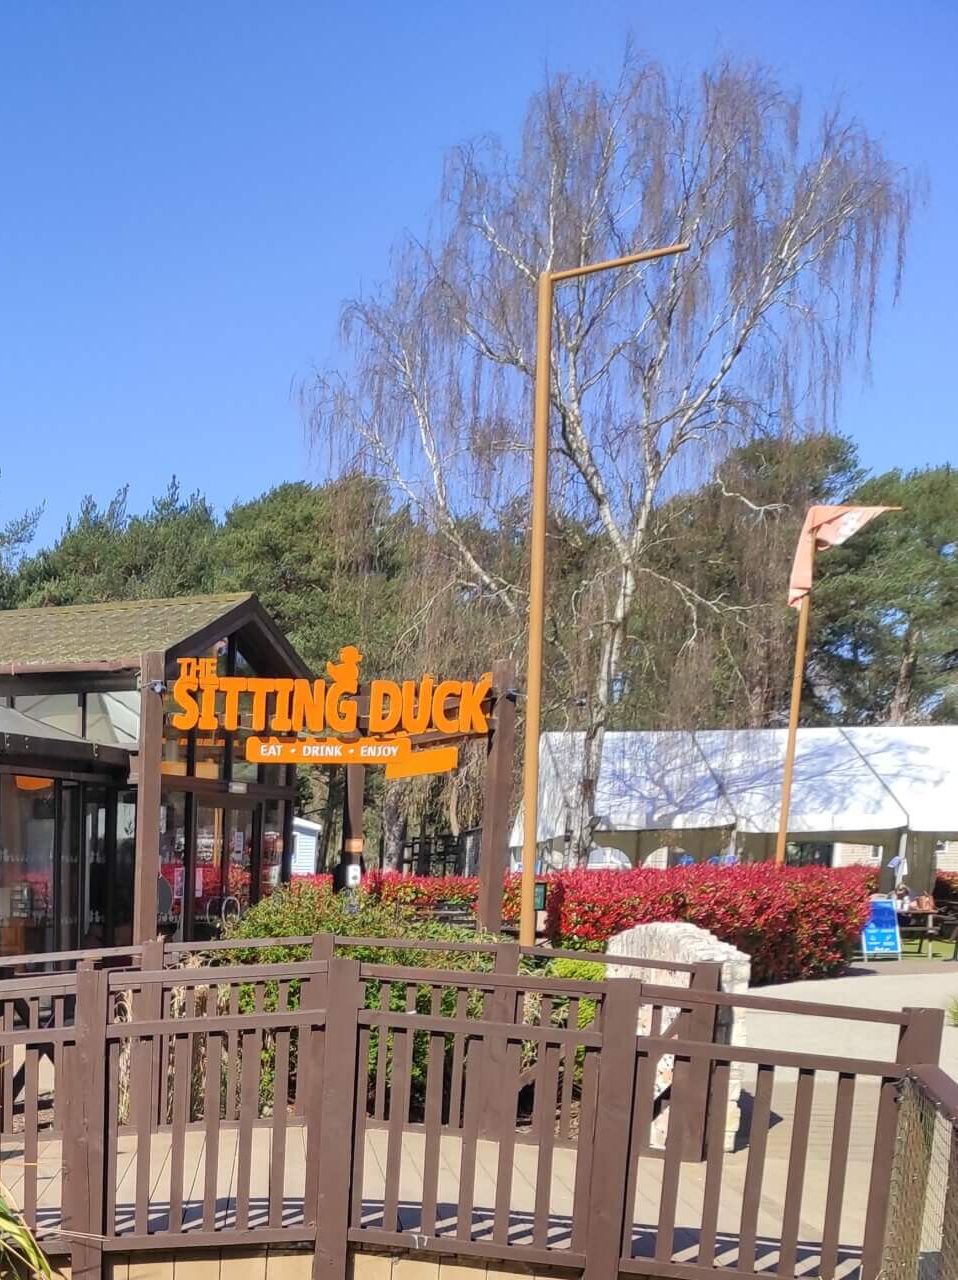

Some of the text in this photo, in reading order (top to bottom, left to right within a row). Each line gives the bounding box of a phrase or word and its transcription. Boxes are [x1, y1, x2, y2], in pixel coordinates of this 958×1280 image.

[176, 657, 218, 684] THE
[172, 674, 492, 734] SITTING DUCK
[260, 744, 400, 757] EAT DRINK ENJOY
